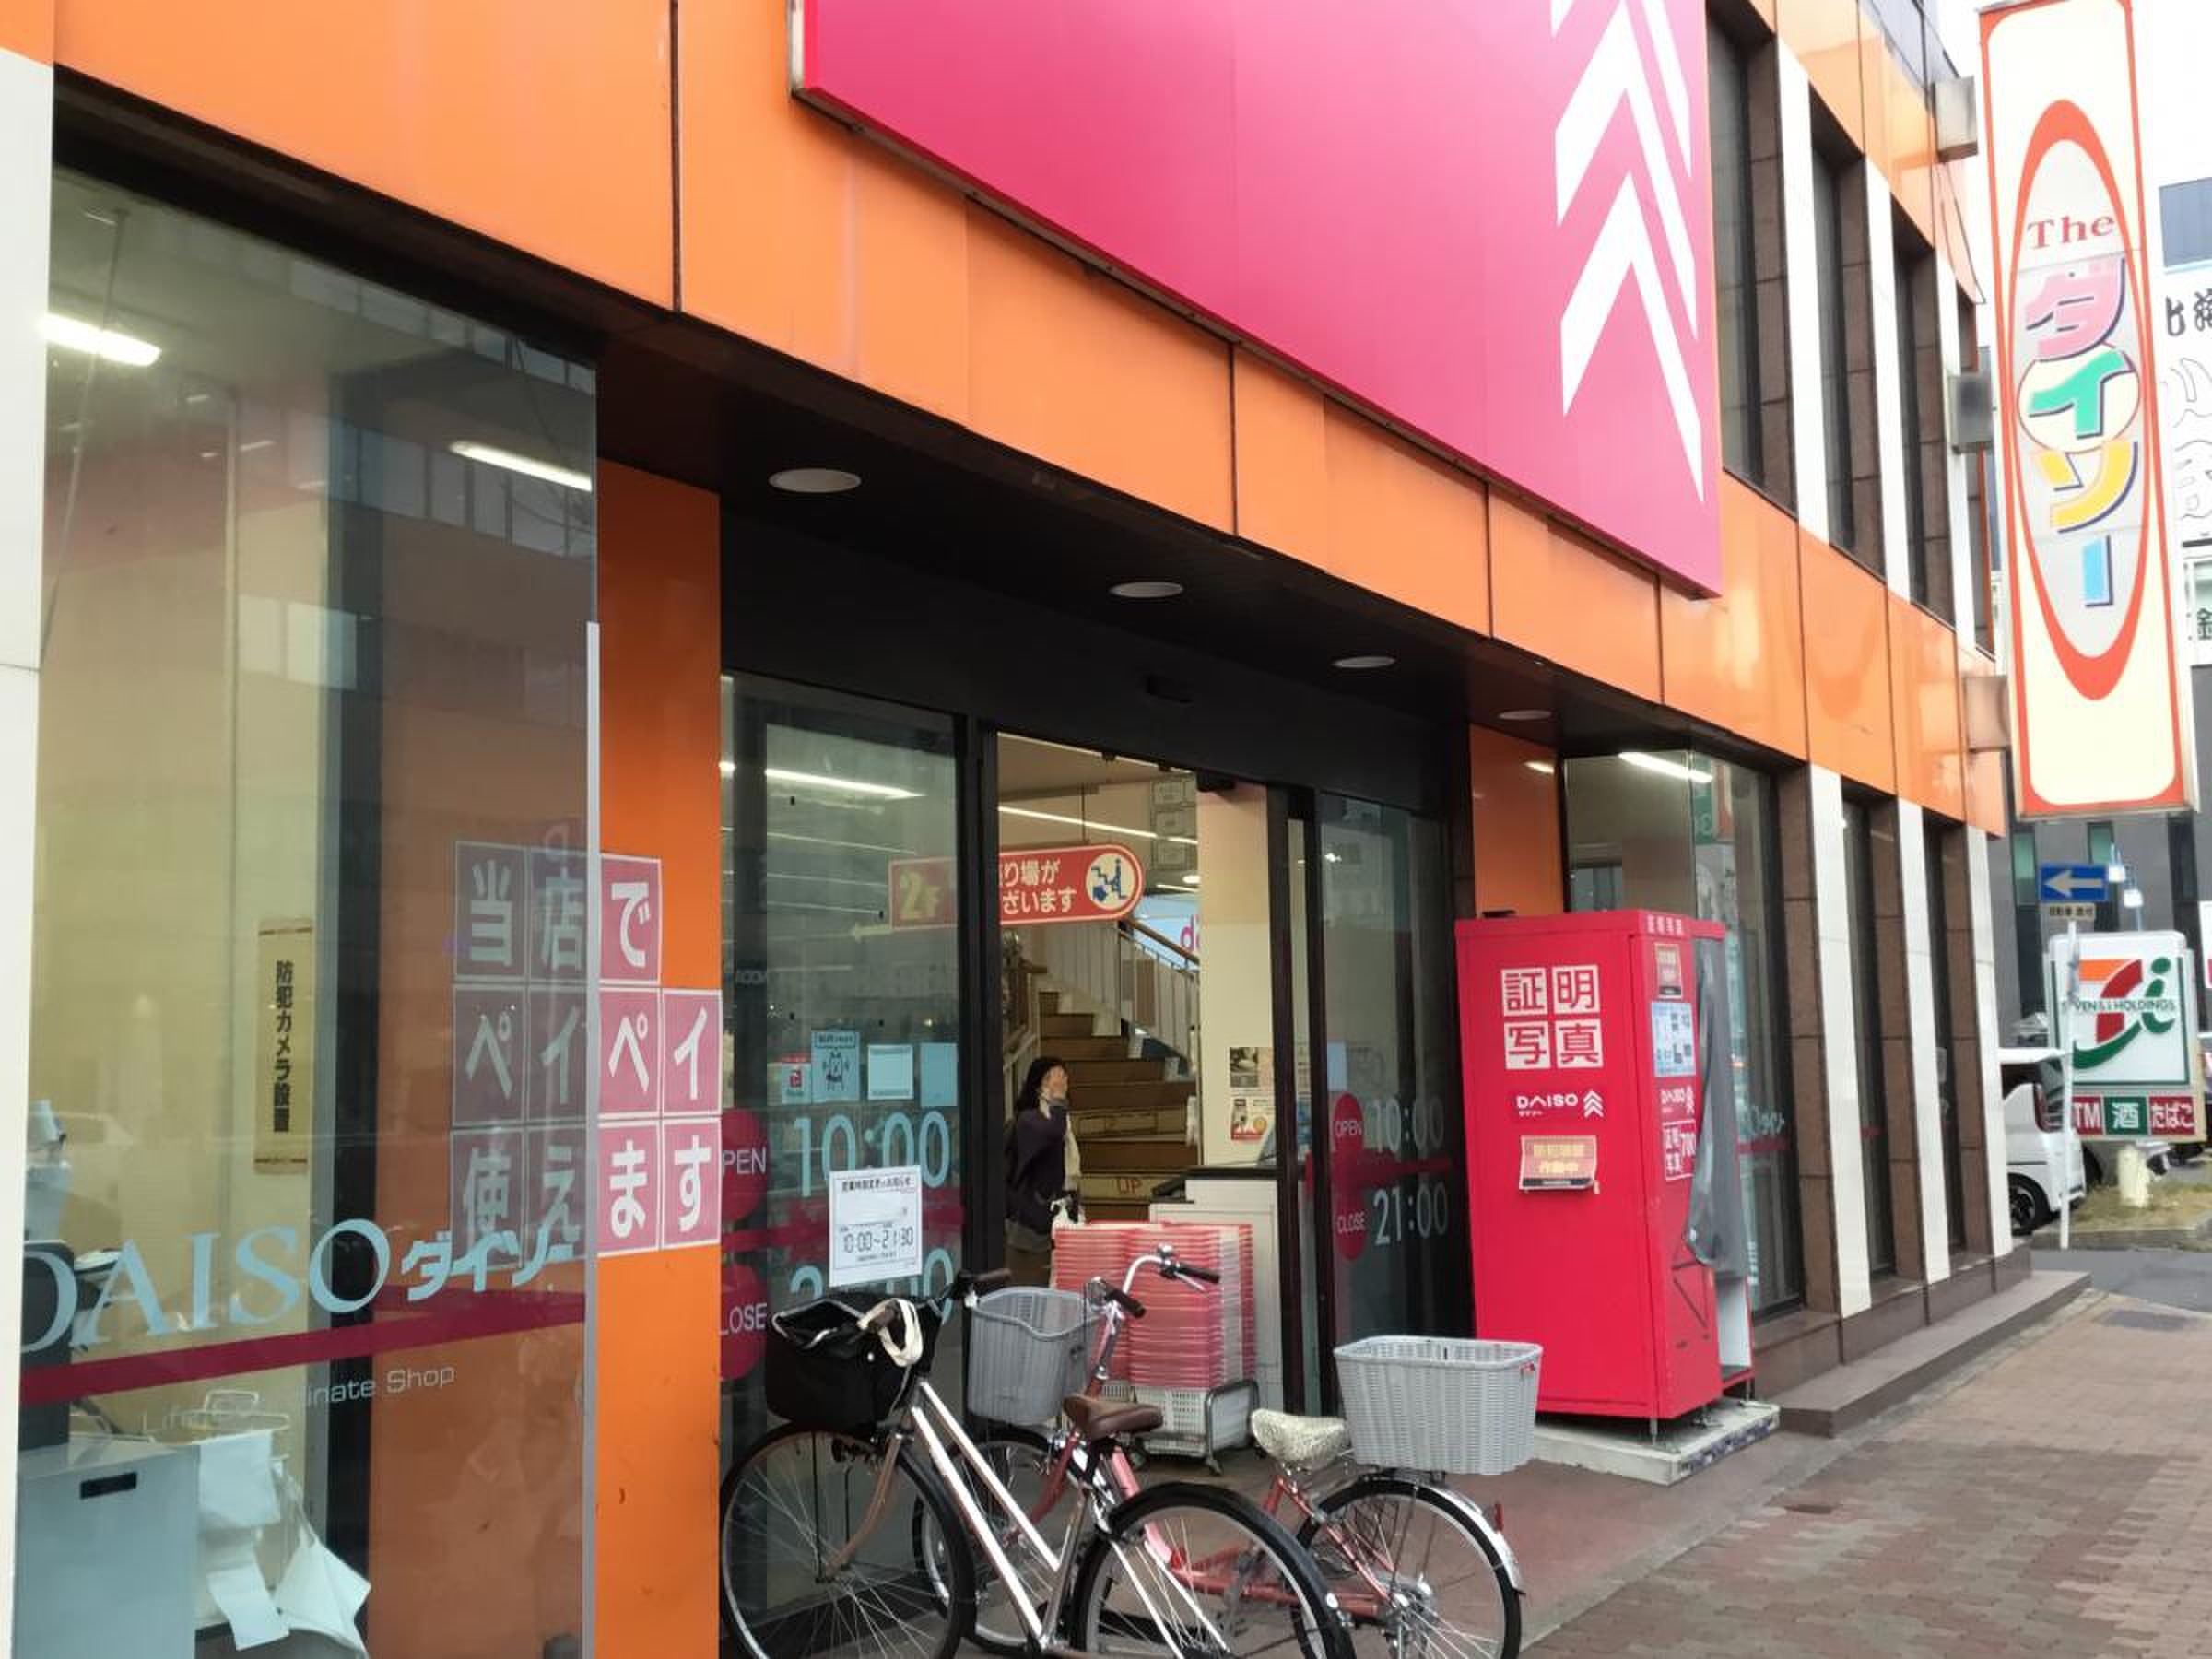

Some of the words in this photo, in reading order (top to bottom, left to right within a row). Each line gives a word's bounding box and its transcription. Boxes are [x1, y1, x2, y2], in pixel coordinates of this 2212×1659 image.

[2027, 216, 2114, 249] The
[2027, 257, 2138, 608] ダイソー
[1000, 858, 1062, 888] り場が
[471, 857, 651, 970] 当店で
[1002, 888, 1077, 915] ざいます
[1503, 968, 1598, 1014] 証明
[465, 1006, 708, 1104] ペイペイ
[1507, 1022, 1600, 1066] 写真
[1516, 1093, 1579, 1109] DAISO
[2075, 1102, 2101, 1129] TM
[2112, 1102, 2139, 1129] 酒
[2151, 1102, 2194, 1129] たばこ
[722, 1148, 767, 1175] PEN
[794, 1111, 950, 1196] 10:00
[463, 1135, 712, 1242] 使えます
[1373, 1182, 1448, 1246] 21:00
[385, 1365, 456, 1394] Shop
